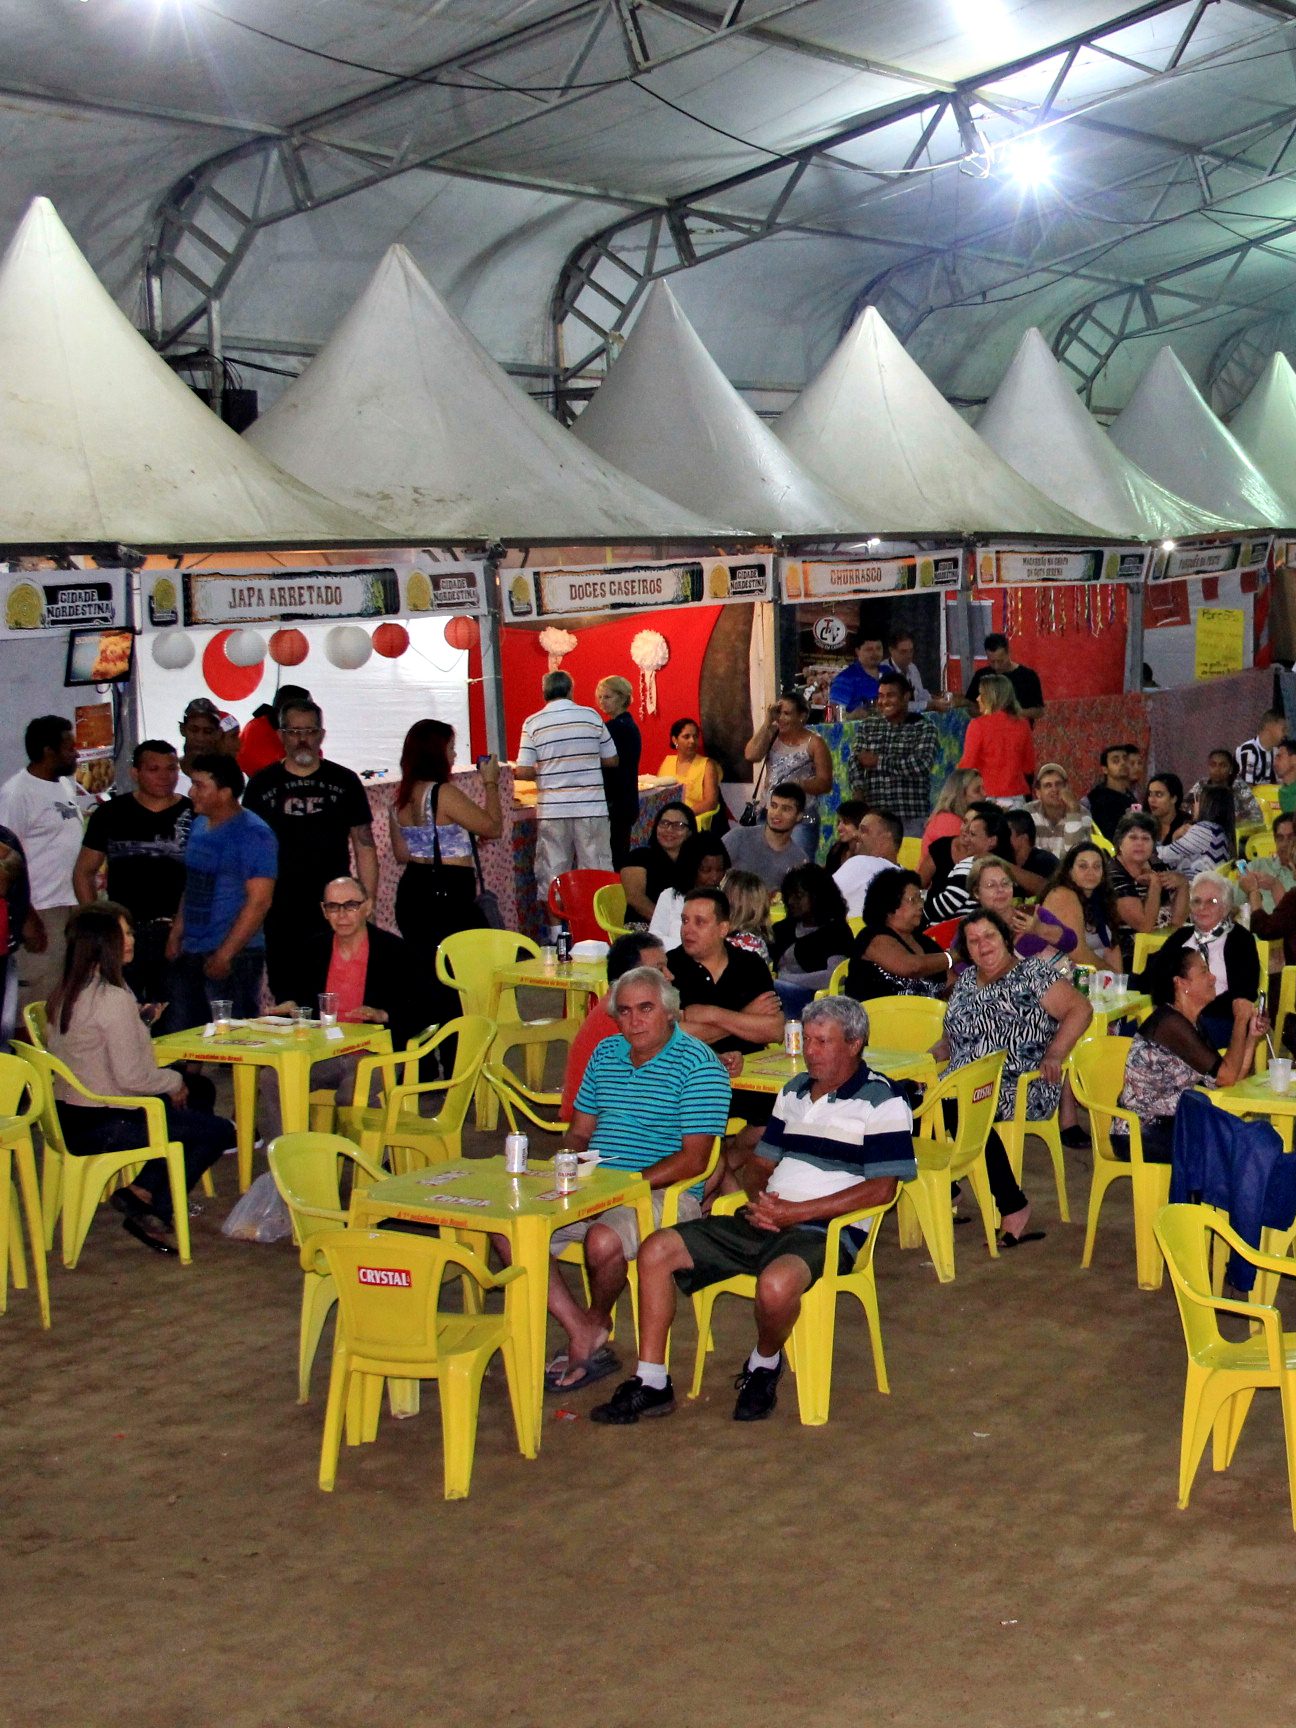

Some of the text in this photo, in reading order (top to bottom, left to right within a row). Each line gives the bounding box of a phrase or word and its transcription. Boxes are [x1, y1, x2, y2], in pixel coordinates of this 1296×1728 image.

[737, 570, 758, 580] CIDADE
[830, 567, 882, 586] CHURRASCO
[441, 578, 467, 589] CIDADE
[569, 578, 662, 600] DOCES CASEIROS
[730, 579, 765, 590] NORDESTINA
[59, 590, 97, 604] CIDADE
[229, 585, 343, 609] JAPA ARRETADO
[434, 589, 478, 601] NORDESTINA
[46, 602, 113, 619] NORDESTINA
[360, 1268, 409, 1286] CRYSTAL
